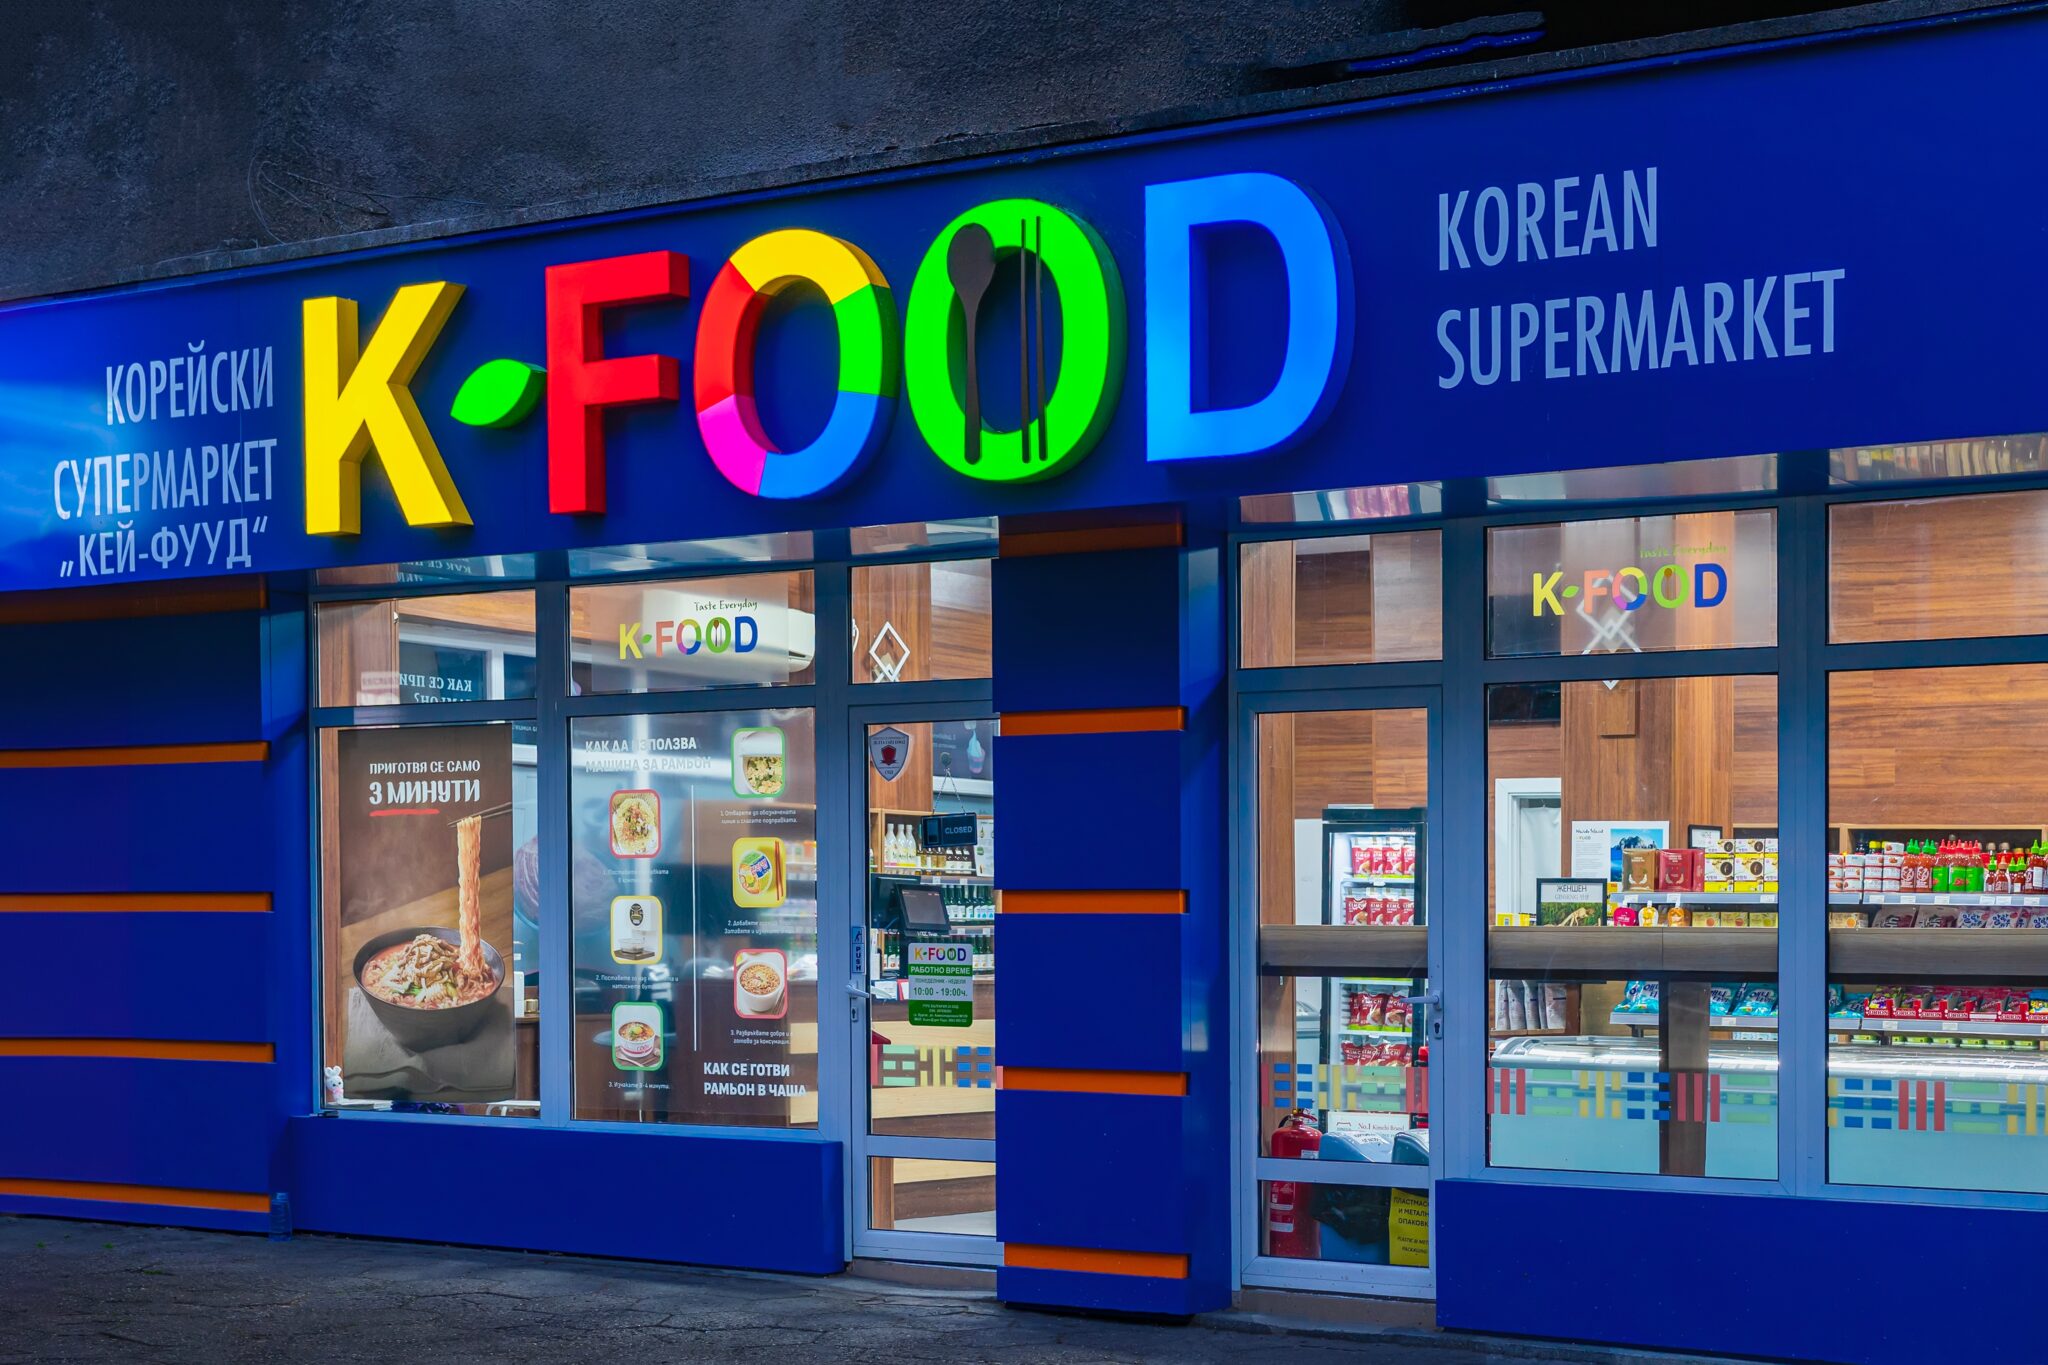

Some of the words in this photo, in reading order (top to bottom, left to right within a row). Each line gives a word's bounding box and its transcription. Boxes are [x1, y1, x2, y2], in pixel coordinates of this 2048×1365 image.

[1438, 166, 1659, 271] KOREAN
[1436, 268, 1846, 390] SUPERMARKET
[105, 339, 274, 426] КОРЕЙСКИ
[53, 438, 278, 520] СУПЕРМАРКЕТ
[694, 601, 718, 612] Taste
[719, 597, 758, 613] Everyday
[584, 740, 610, 753] КАК
[369, 761, 427, 775] ПРИГОТВЯ
[430, 760, 444, 773] СЕ
[446, 759, 481, 773] САМО
[368, 781, 383, 806] 3
[386, 779, 481, 805] МИНУТИ
[944, 825, 973, 835] CLOSED
[910, 966, 945, 974] РАБОТНО
[945, 967, 971, 975] ВРЕМЕ
[913, 986, 934, 996] 10:00
[703, 1062, 729, 1076] КАК
[731, 1062, 748, 1076] СЕ
[750, 1063, 790, 1077] ГОТВИ
[703, 1082, 755, 1097] РАМЬОН
[757, 1083, 767, 1097] В
[768, 1083, 807, 1098] ЧАША
